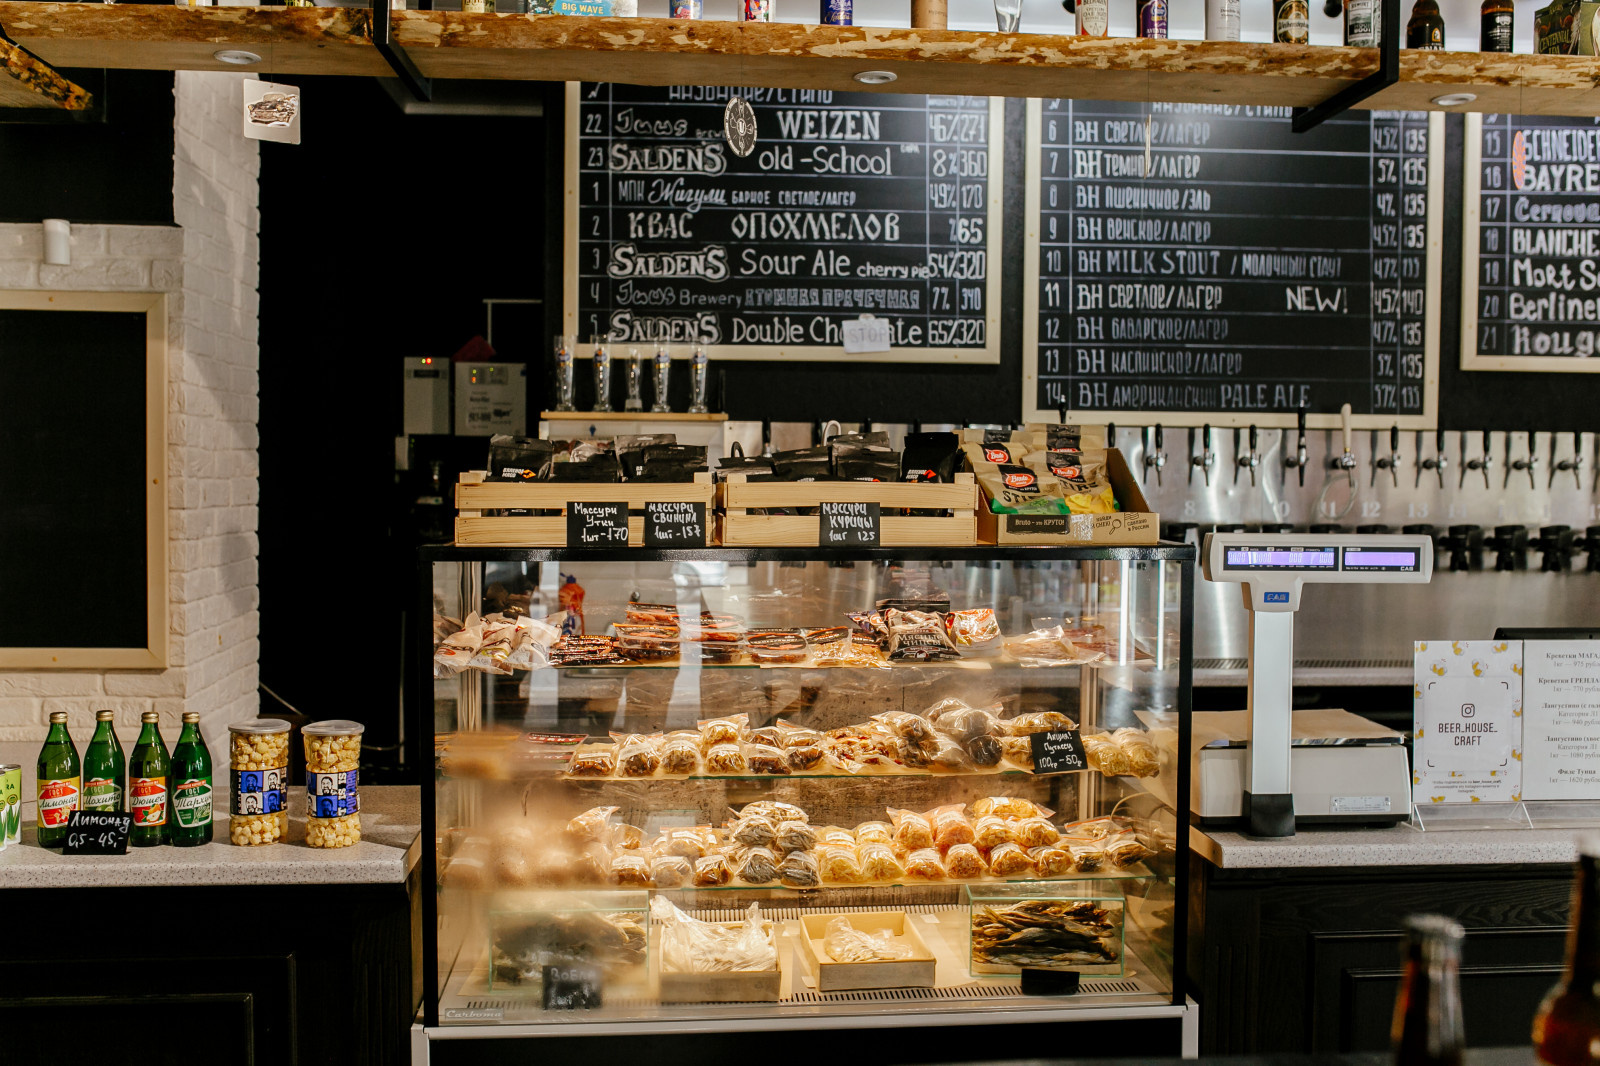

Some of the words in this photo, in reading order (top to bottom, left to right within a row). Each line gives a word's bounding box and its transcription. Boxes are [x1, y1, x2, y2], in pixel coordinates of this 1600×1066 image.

[562, 3, 577, 12] BIG
[579, 4, 604, 15] WAVE
[585, 113, 602, 134] 22
[776, 110, 881, 141] WEIZEN
[1048, 119, 1058, 142] 6
[1404, 128, 1427, 152] 135
[1484, 130, 1501, 157] 15
[587, 147, 604, 168] 23
[609, 140, 726, 174] SALDEN'S
[959, 149, 988, 178] 360
[1049, 151, 1059, 175] 7
[1377, 158, 1397, 184] 5%
[1403, 158, 1427, 186] 135
[1484, 165, 1502, 189] 16
[592, 181, 600, 202] 1
[647, 177, 728, 213] Жигули
[731, 190, 771, 206] БАРНОЕ
[961, 183, 983, 209] 170
[1049, 184, 1058, 208] 8
[1376, 193, 1397, 217] 4%
[1403, 193, 1426, 217] 135
[1484, 196, 1501, 220] 17
[592, 215, 601, 237] 2
[628, 211, 694, 240] КВАС
[731, 211, 900, 242] ОПОХМЕЛОВ
[957, 217, 985, 245] 65
[1049, 216, 1058, 240] 9
[1403, 224, 1425, 249] 135
[1512, 228, 1600, 257] BLANCHE
[592, 248, 601, 270] 3
[608, 242, 730, 282] SALDEN'S
[739, 248, 806, 276] Sour
[811, 248, 851, 277] Ale
[856, 261, 909, 279] cherry
[911, 262, 930, 279] pie
[958, 250, 987, 280] 320
[1046, 249, 1062, 273] 10
[1106, 249, 1157, 274] MILK
[1160, 250, 1221, 276] STOUT
[1484, 260, 1500, 286] 19
[590, 281, 601, 304] 4
[679, 288, 743, 309] Brewery
[821, 288, 921, 310] ПРАЧЕЧНАЯ
[960, 286, 982, 311] 340
[1045, 282, 1060, 308] 11
[1285, 284, 1349, 315] NEW!
[1401, 288, 1425, 316] 140
[1482, 294, 1500, 319] 20
[590, 313, 599, 335] 5
[609, 308, 723, 345] SALDEN'S
[731, 315, 806, 344] Double
[957, 319, 986, 346] 320
[847, 327, 888, 344] STOP
[1045, 317, 1060, 340] 12
[1402, 321, 1422, 346] 135
[1481, 325, 1498, 351] 21
[1045, 348, 1060, 373] 13
[1401, 353, 1424, 380] 135
[1220, 383, 1268, 409] PALE
[1272, 384, 1313, 409] ALE
[829, 515, 875, 529] КУРИЦЫ
[1184, 501, 1196, 517] 8
[1361, 501, 1381, 518] 12
[1407, 502, 1429, 519] 13
[1015, 519, 1032, 527] Bruto
[1044, 518, 1066, 527] КРУТО!
[857, 530, 876, 542] 125
[1047, 731, 1073, 742] Акция!
[1454, 735, 1482, 747] CRAFT
[39, 793, 79, 809] Лимонад
[48, 788, 64, 797] ГОСТ
[131, 793, 165, 806] Дюшес
[184, 786, 201, 796] ГОСТ
[445, 1009, 503, 1020] Carboma
